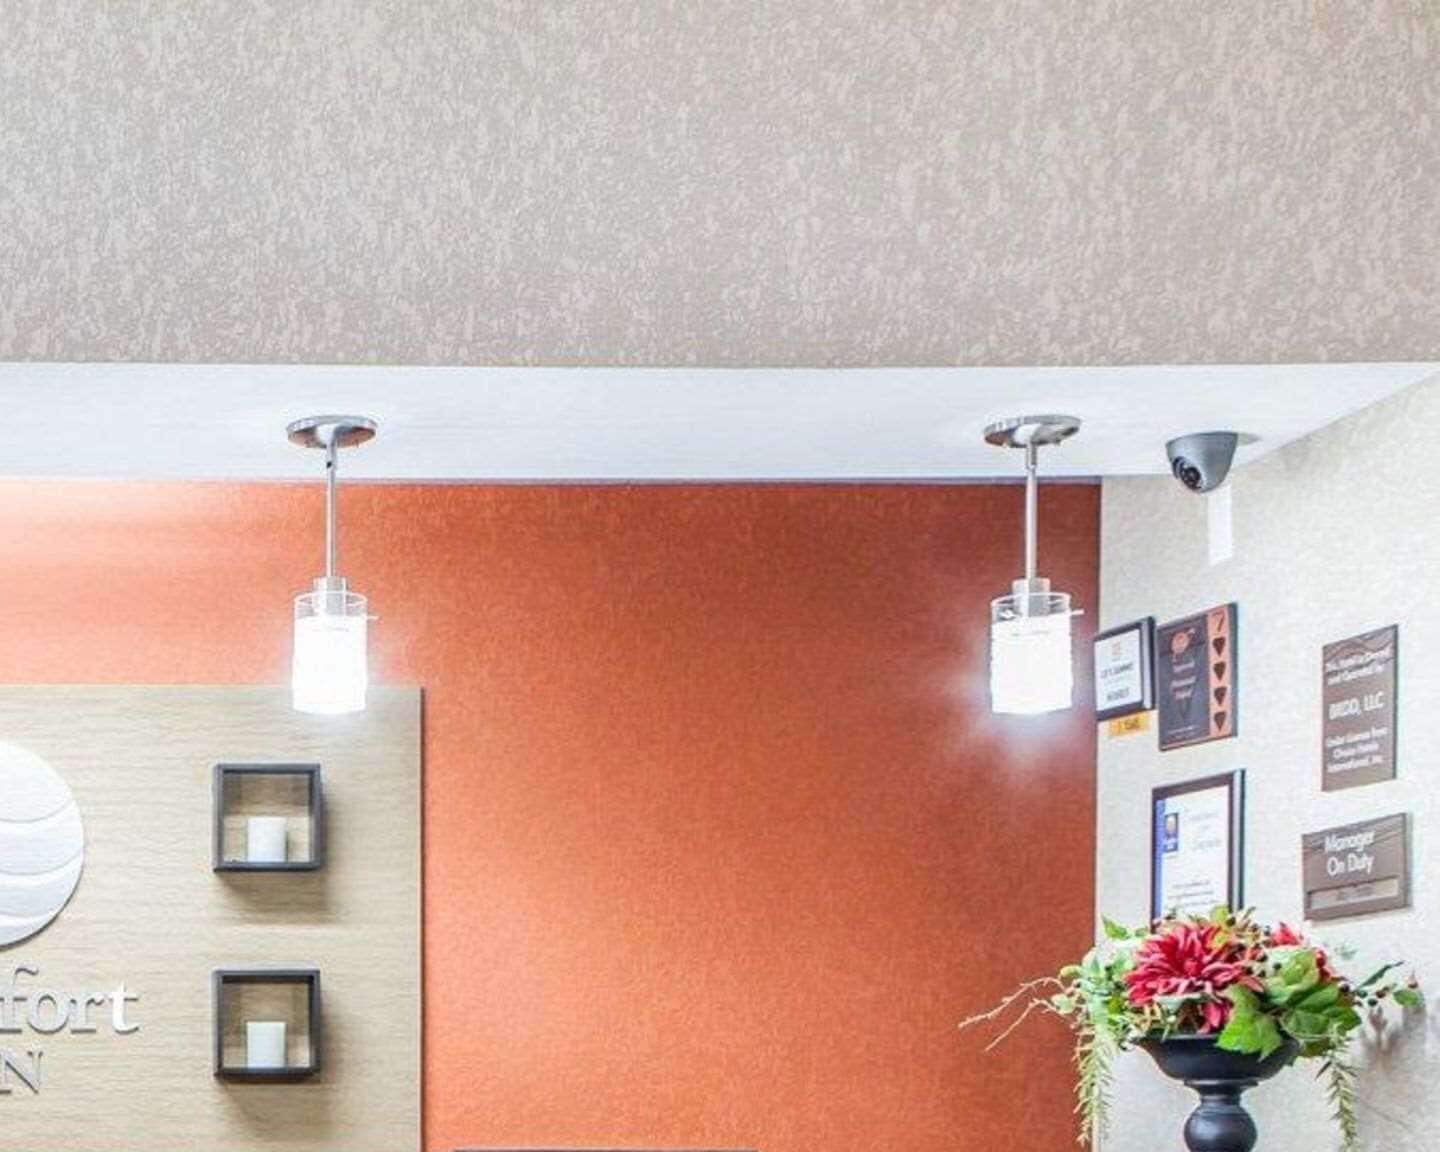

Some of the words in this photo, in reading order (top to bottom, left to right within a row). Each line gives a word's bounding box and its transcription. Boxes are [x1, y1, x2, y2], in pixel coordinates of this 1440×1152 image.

[1363, 689, 1385, 712] LLC
[1326, 856, 1345, 876] On
[1346, 852, 1375, 876] Duty
